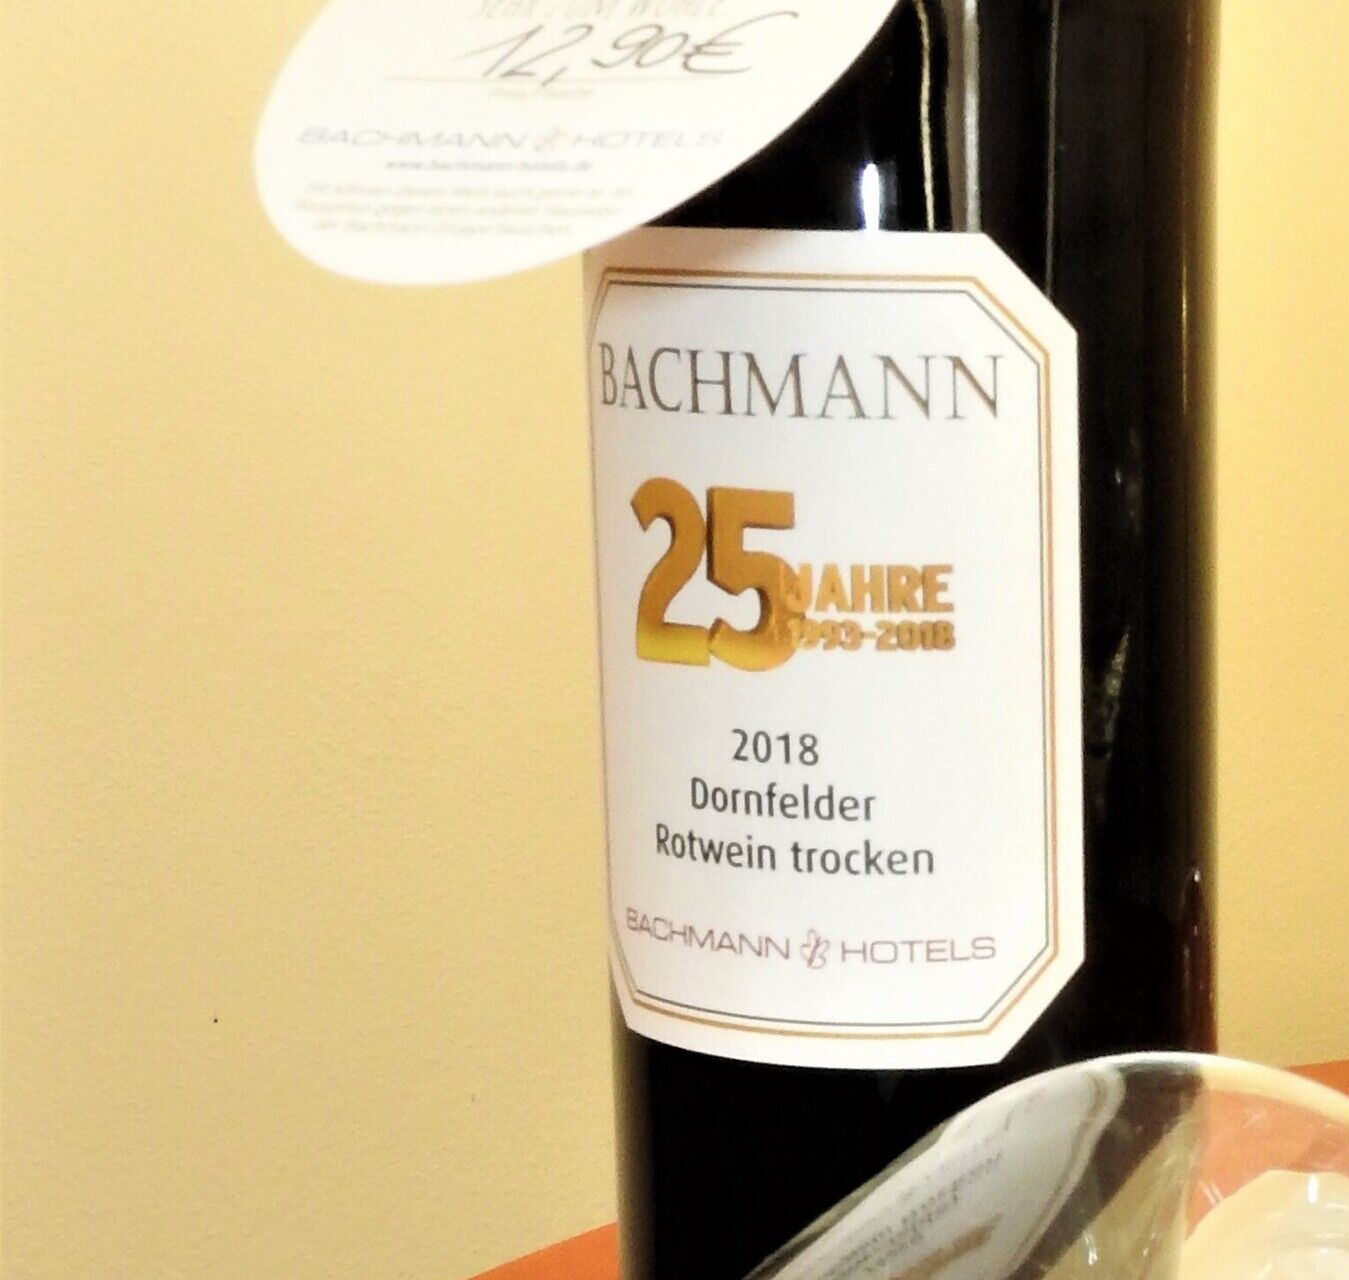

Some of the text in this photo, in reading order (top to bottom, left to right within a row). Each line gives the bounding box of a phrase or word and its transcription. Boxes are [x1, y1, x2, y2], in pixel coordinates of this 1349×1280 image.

[452, 11, 799, 86] 12,90€
[297, 125, 724, 150] BACHMANN HOTELS
[599, 342, 1003, 420] BACHMANN
[631, 478, 955, 671] 25 JAHRE
[731, 728, 820, 767] 2018
[690, 777, 877, 821] Dornfelder
[655, 823, 935, 876] Rotwein trocken
[625, 907, 996, 964] BACHMANN HOTELS
